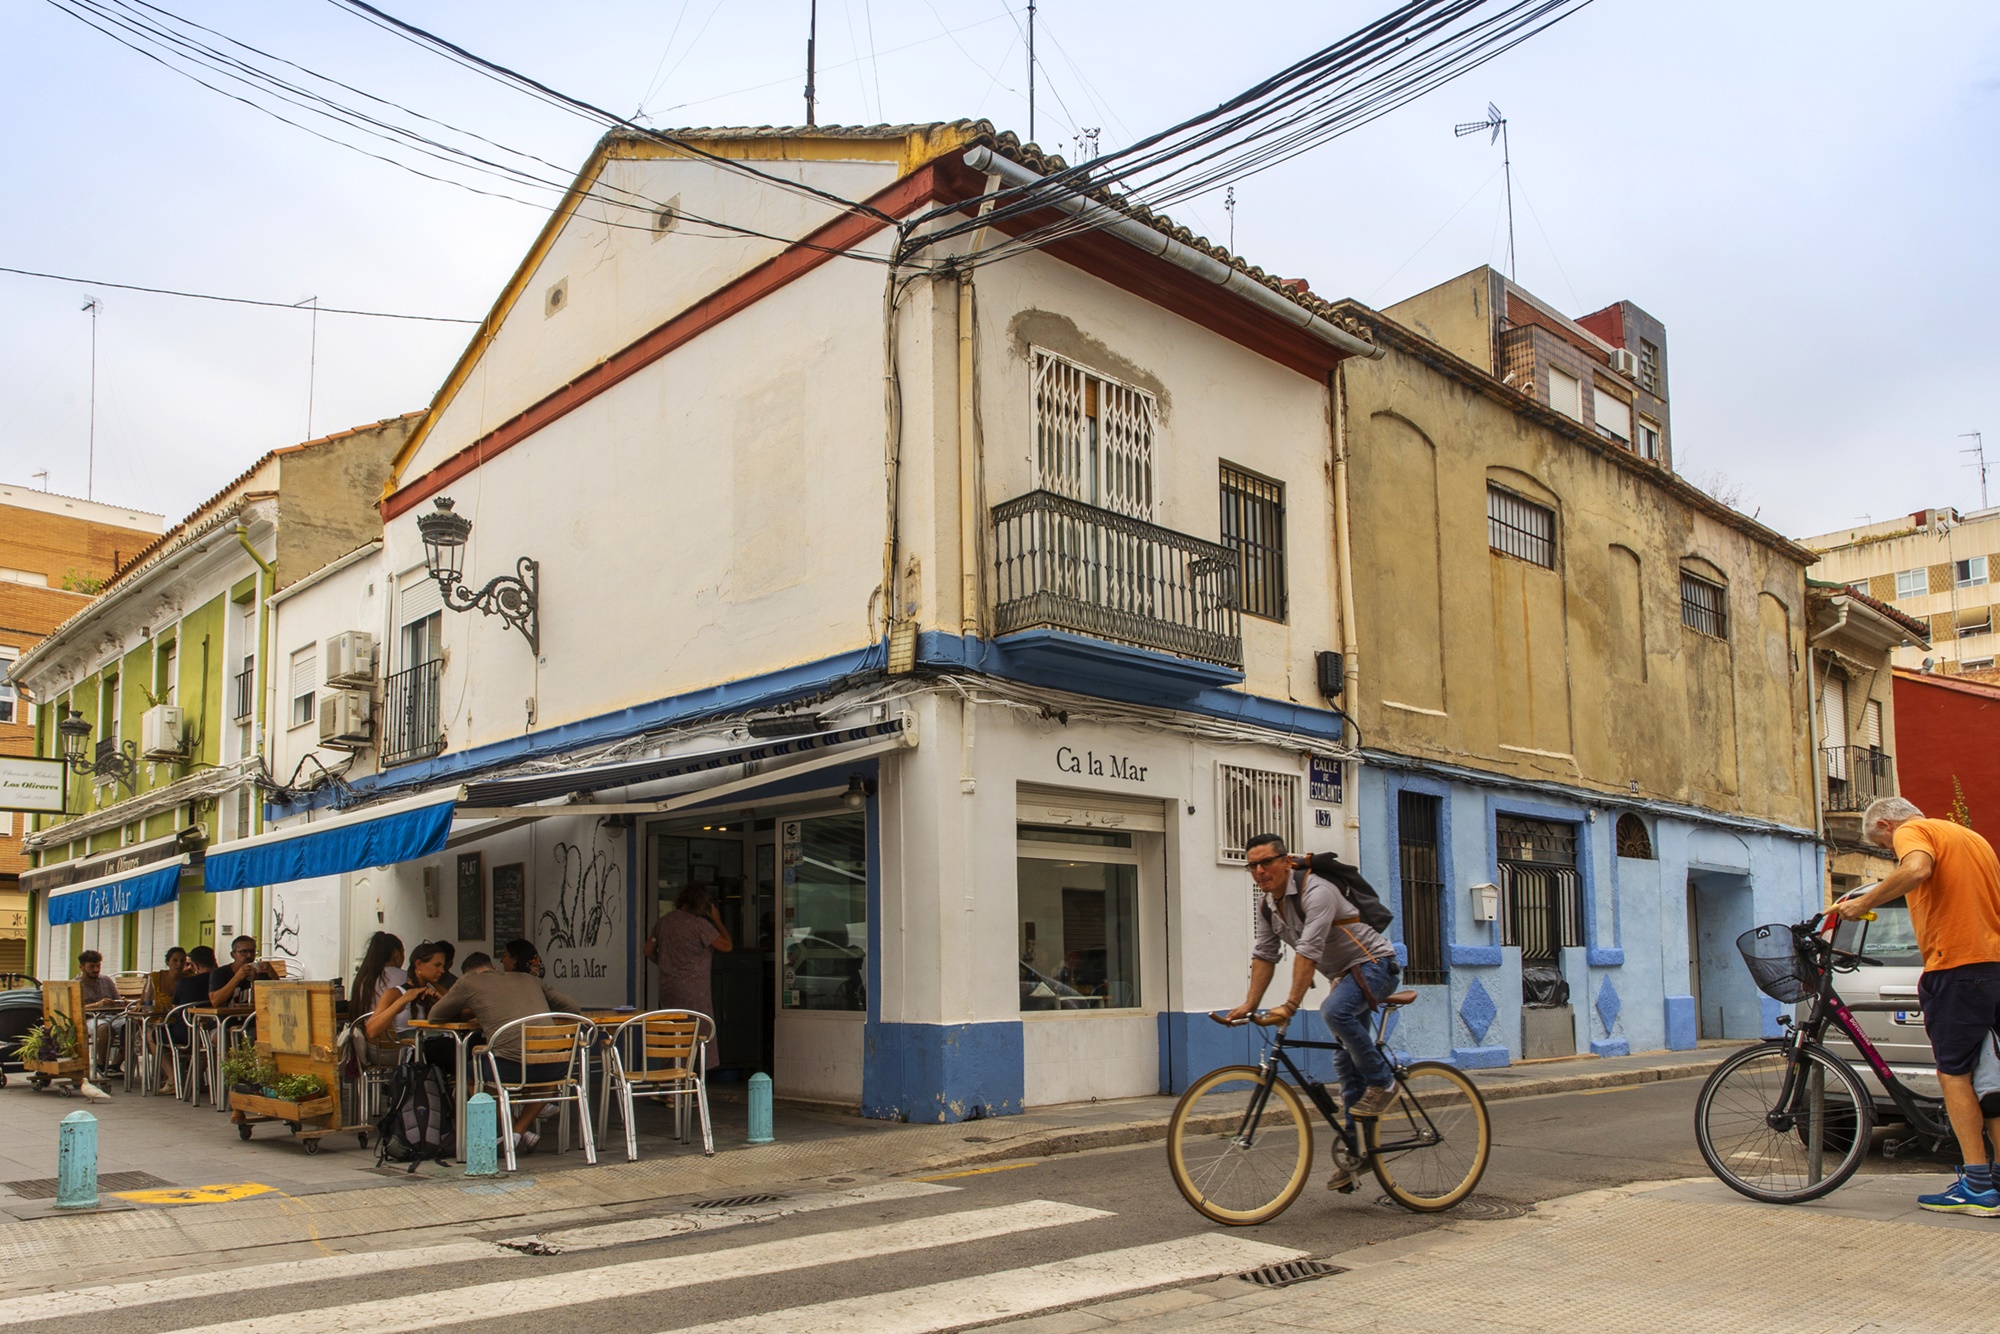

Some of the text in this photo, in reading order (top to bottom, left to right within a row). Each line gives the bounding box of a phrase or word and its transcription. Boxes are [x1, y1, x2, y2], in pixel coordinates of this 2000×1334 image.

[1056, 746, 1148, 782] Ca la Mar
[1313, 758, 1339, 774] CALLE
[3, 780, 59, 790] Los Olivares
[1322, 773, 1330, 782] DE
[1310, 781, 1342, 803] ESCALANTE
[1316, 809, 1332, 826] 137
[104, 856, 140, 876] Los Olivares
[461, 860, 477, 875] PLAT
[88, 884, 131, 918] Ca la Mar
[553, 958, 607, 979] Ca la Mar
[277, 1013, 299, 1028] TURIA
